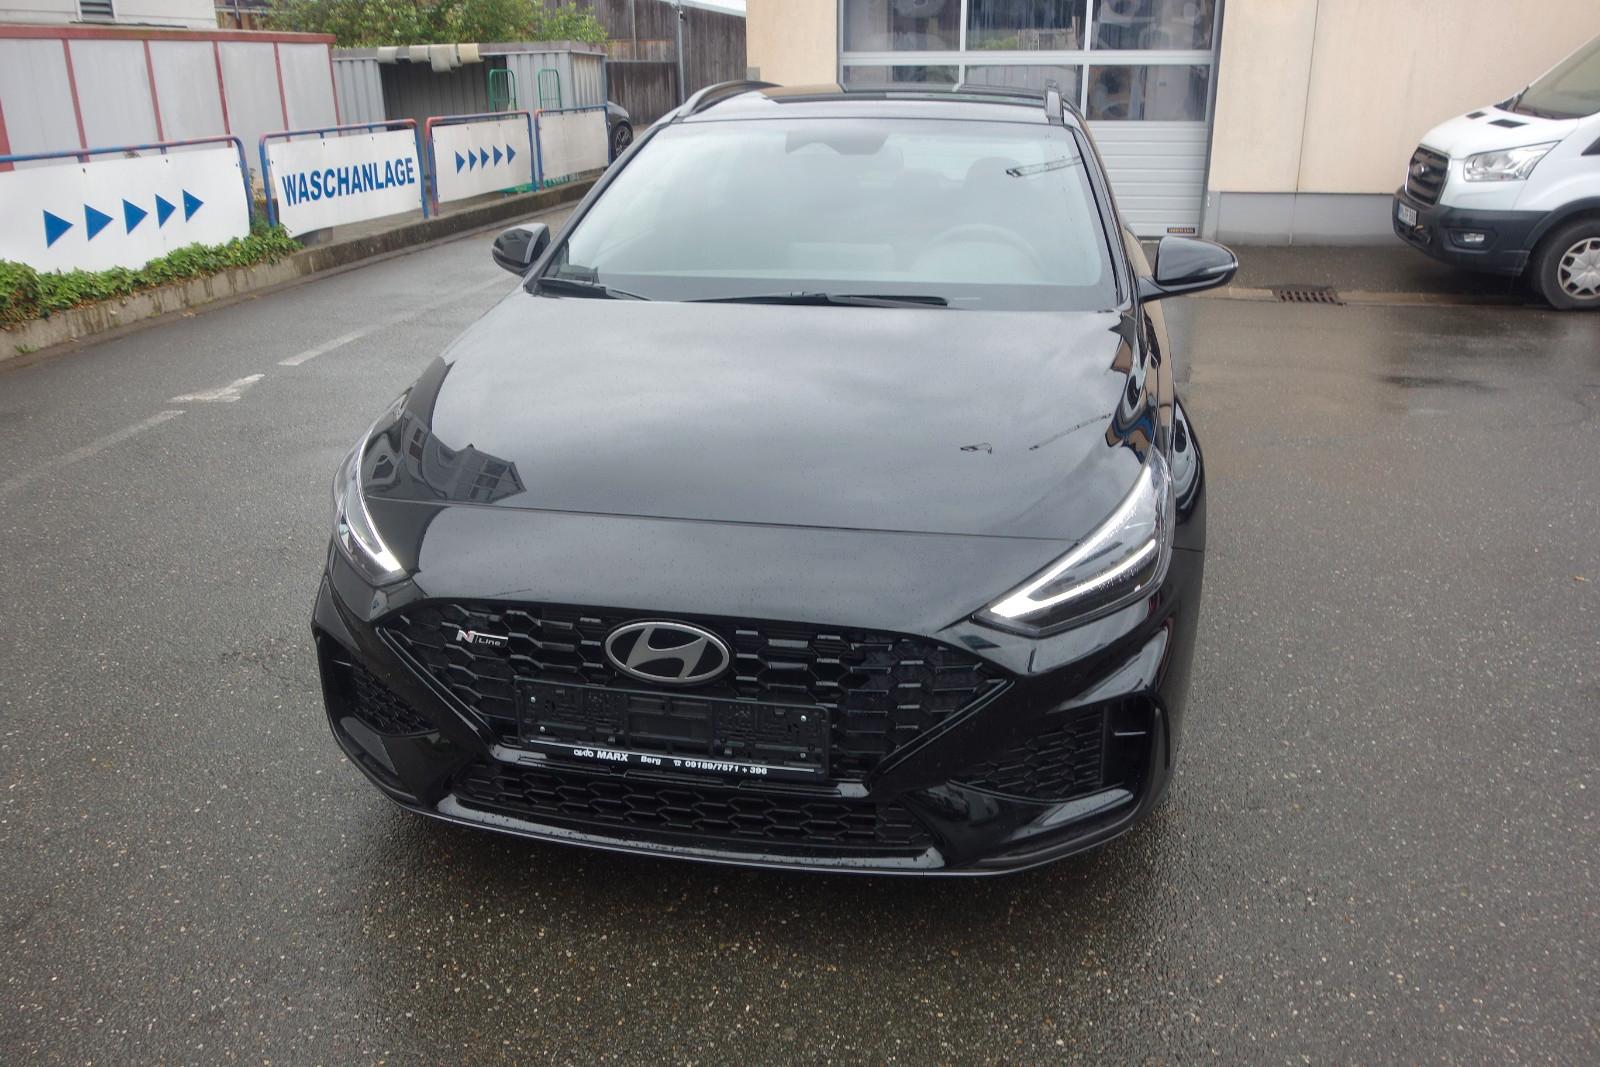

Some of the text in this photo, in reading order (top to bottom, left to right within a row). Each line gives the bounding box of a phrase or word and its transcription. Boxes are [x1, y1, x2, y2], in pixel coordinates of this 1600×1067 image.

[281, 157, 416, 207] WASCHANLAGE
[597, 751, 629, 762] MARX
[640, 756, 661, 765] Berg
